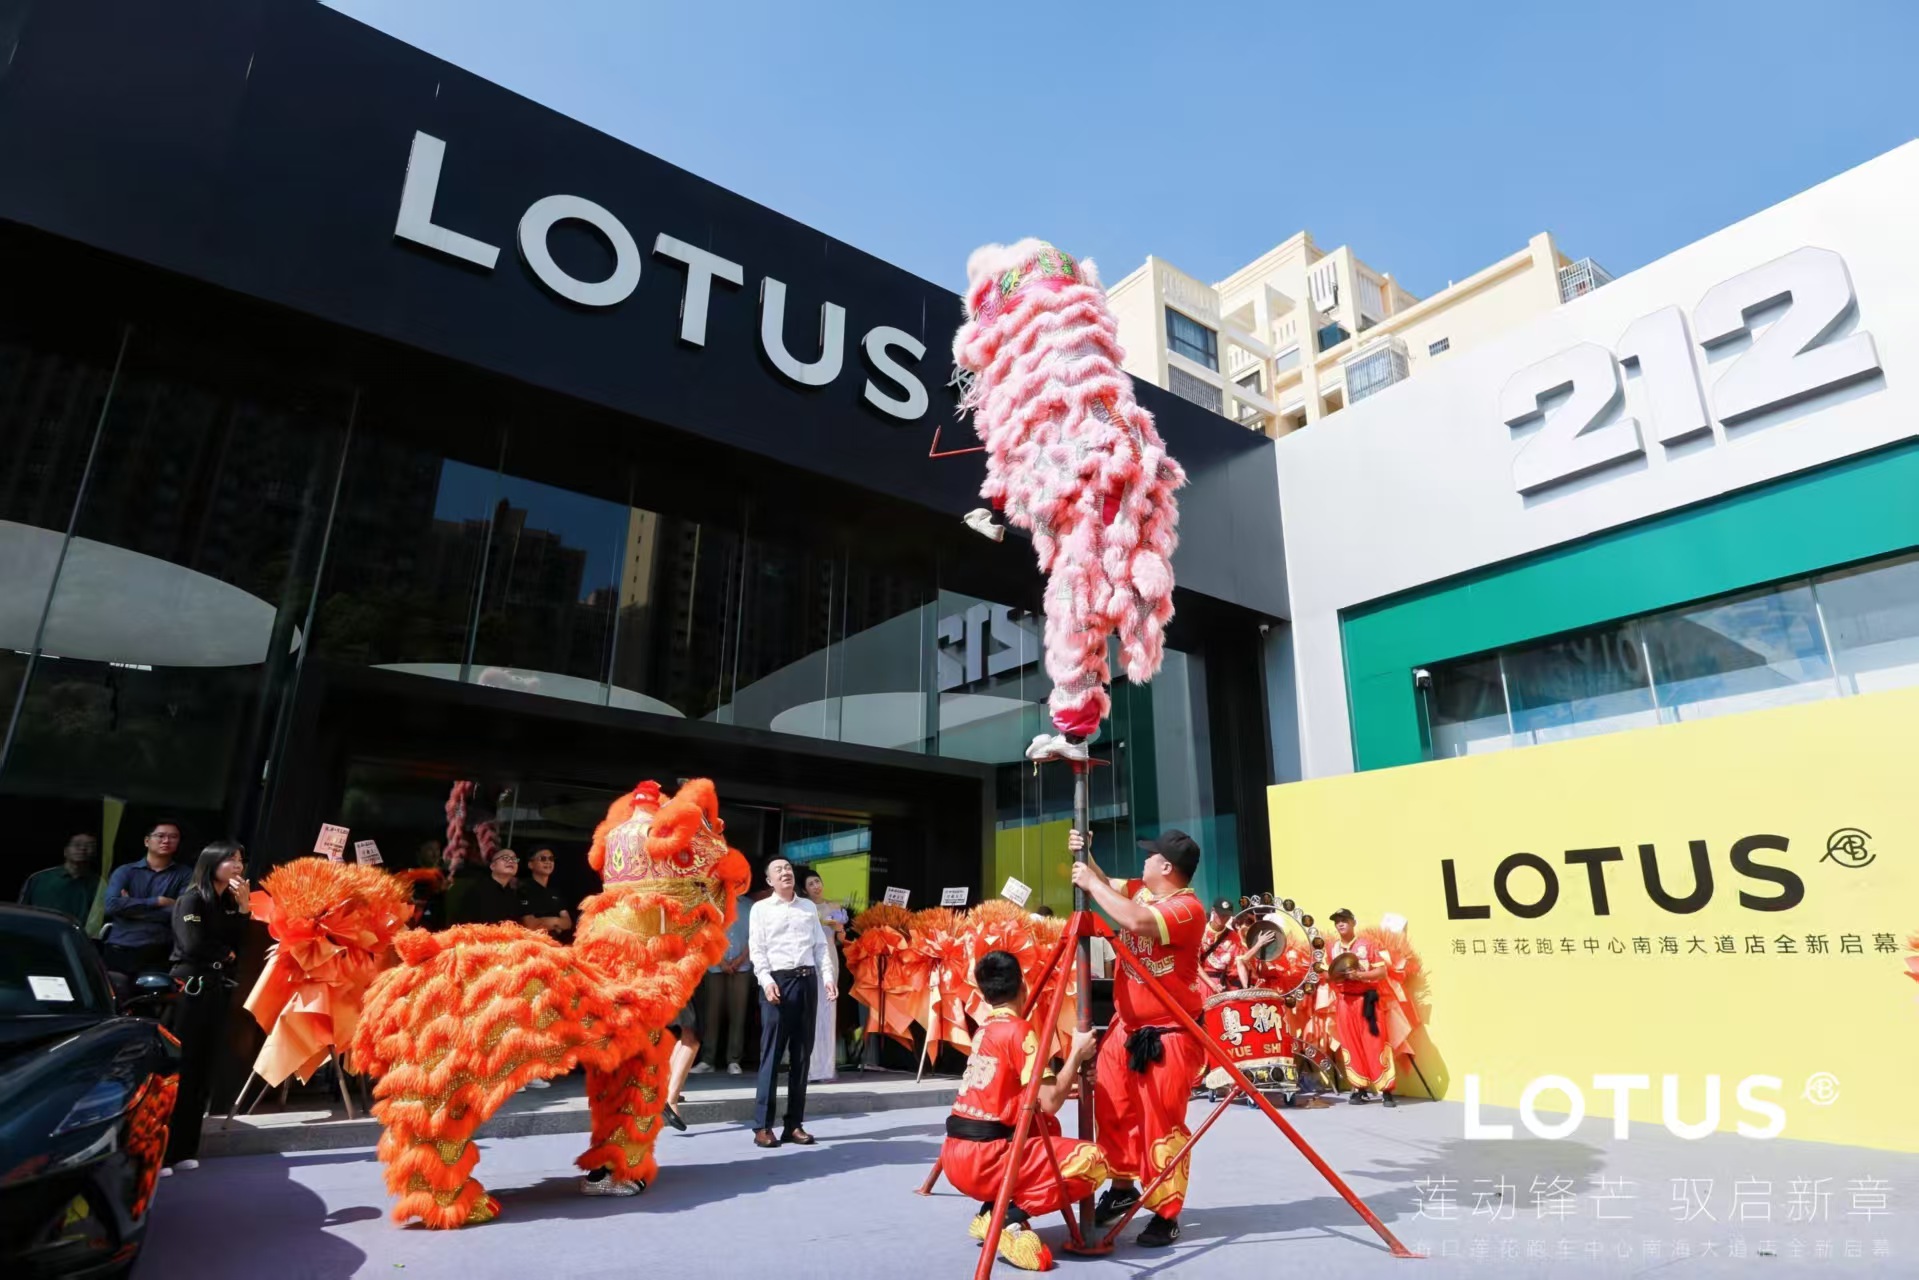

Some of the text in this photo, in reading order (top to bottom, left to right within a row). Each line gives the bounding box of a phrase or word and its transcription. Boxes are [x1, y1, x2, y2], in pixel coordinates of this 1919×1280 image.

[393, 129, 929, 420] LOTUS
[1499, 245, 1885, 497] 212
[1441, 834, 1805, 920] LOTUS
[1451, 932, 1900, 955] 海口莲花跑车中心南海大道店全新启幕
[1227, 1042, 1281, 1058] YUE SHI
